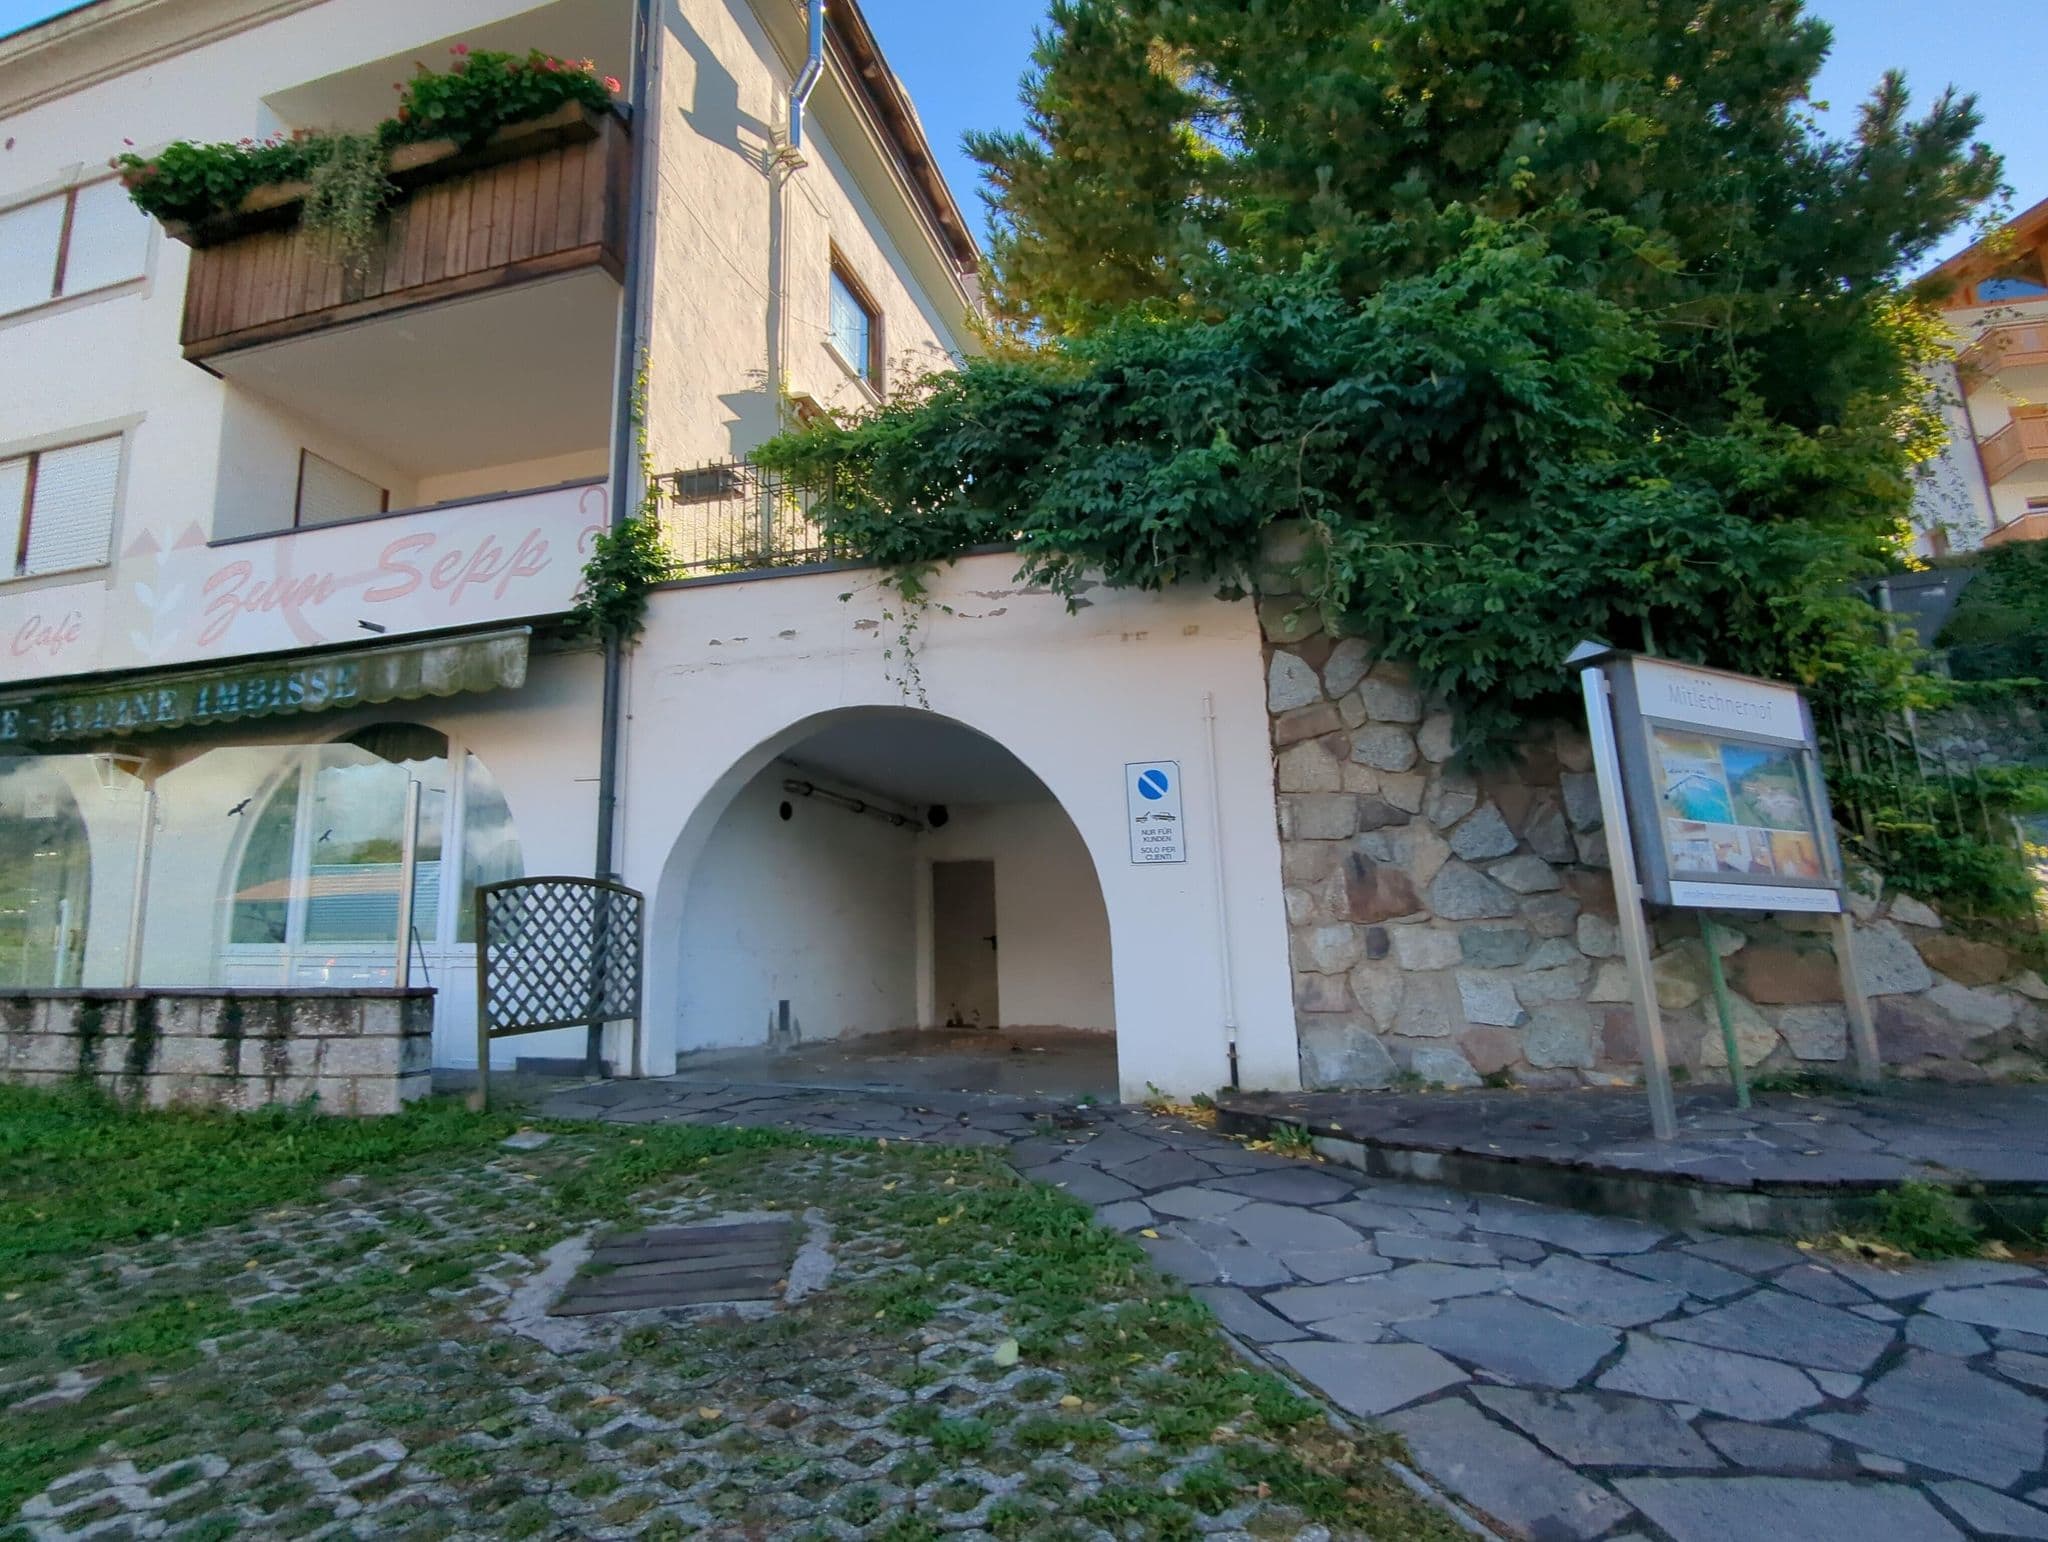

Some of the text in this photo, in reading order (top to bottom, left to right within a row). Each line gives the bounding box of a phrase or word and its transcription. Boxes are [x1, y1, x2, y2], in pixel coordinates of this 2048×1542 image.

[197, 526, 553, 648] Zum Sepp
[194, 663, 362, 716] IMBISSE
[1158, 827, 1173, 835] FÜR
[1145, 853, 1172, 861] CLIENTI
